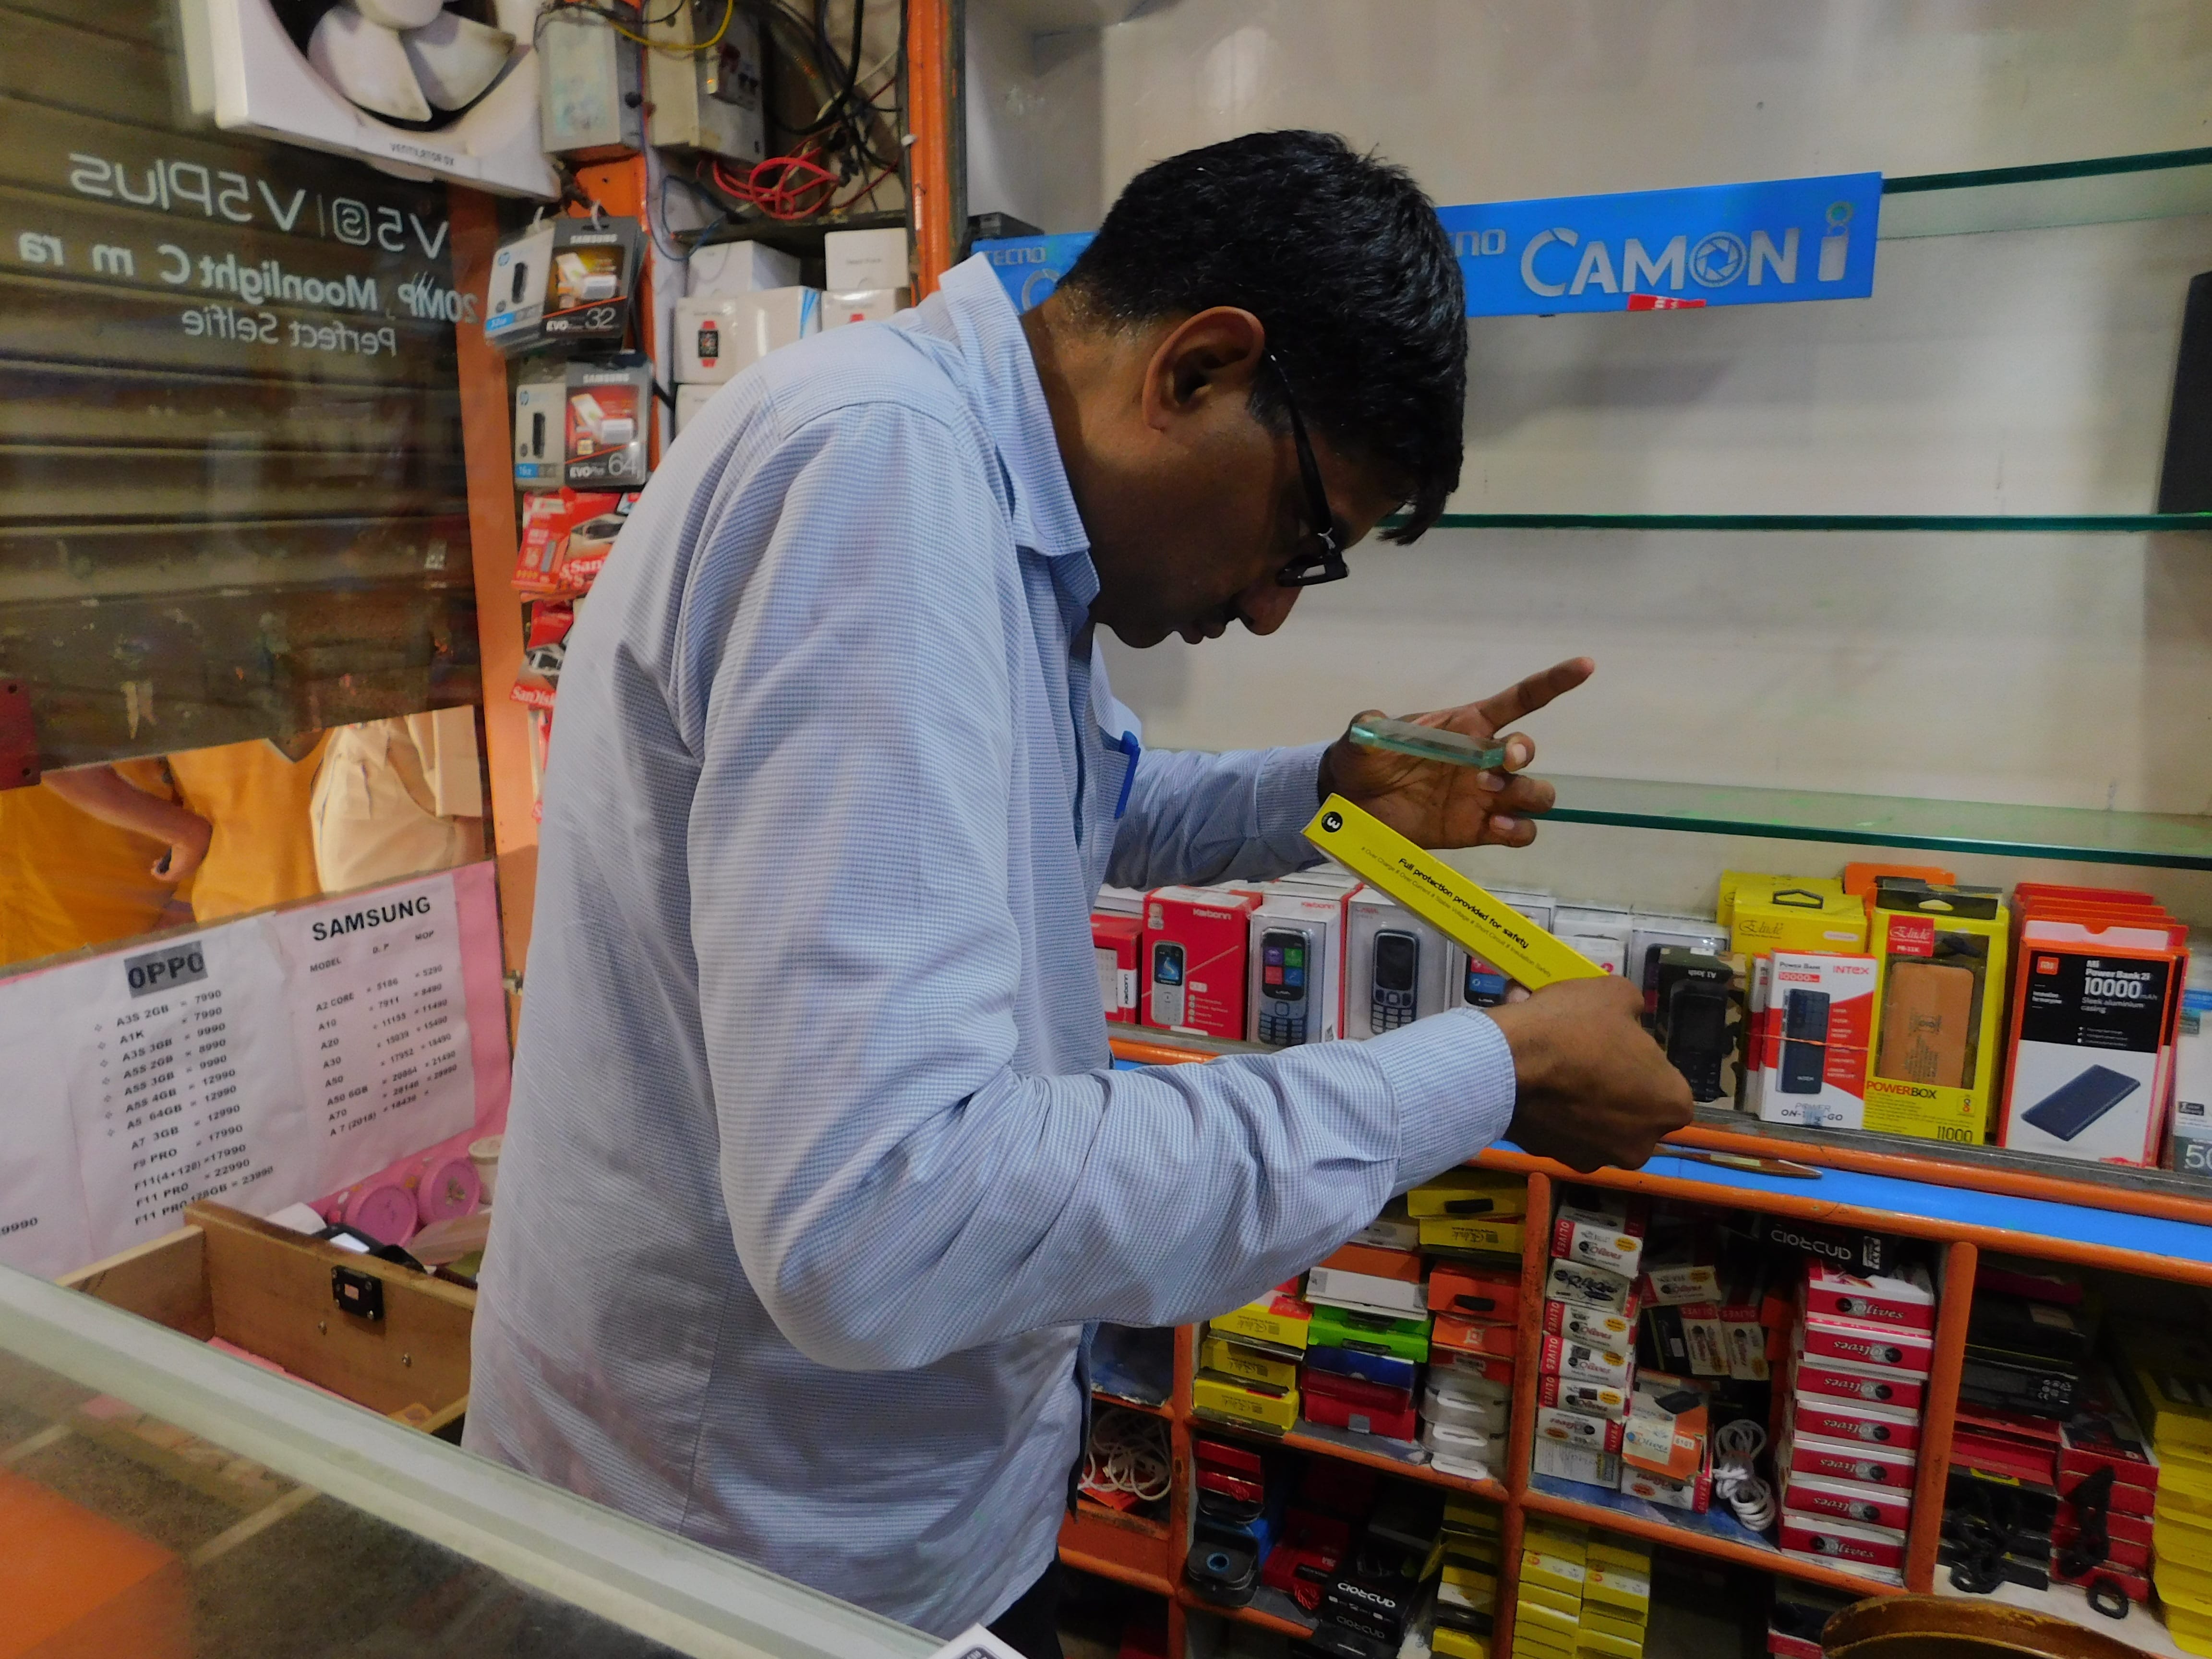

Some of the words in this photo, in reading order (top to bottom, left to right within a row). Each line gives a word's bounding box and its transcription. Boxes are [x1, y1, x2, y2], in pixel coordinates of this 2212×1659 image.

[584, 307, 616, 329] 32
[1398, 857, 1414, 871] Full
[1413, 868, 1453, 898] protection
[1453, 895, 1490, 921] provided
[1488, 918, 1502, 929] for
[1502, 927, 1529, 950] safety
[313, 896, 431, 941] SAMSUNG
[128, 952, 204, 989] OPPO
[310, 957, 342, 973] MODEL
[2085, 968, 2116, 978] Power
[2116, 970, 2140, 980] Bank
[117, 1012, 140, 1027] A3S
[145, 1004, 169, 1019] 2GB
[194, 989, 222, 1004] 7990
[330, 992, 354, 1007] CORE
[120, 1030, 145, 1044] A1K
[194, 1007, 223, 1021] 7990
[197, 1022, 226, 1037] 9990
[318, 1018, 337, 1031] A10
[320, 1037, 339, 1050] A20
[150, 1054, 174, 1070] 2GB
[199, 1054, 227, 1070] 9990
[323, 1057, 342, 1069] A30
[152, 1087, 177, 1103] 4GB
[203, 1069, 236, 1086] 12990
[1866, 1080, 1937, 1100] POWERBOX
[149, 1104, 182, 1120] 64GB
[205, 1085, 237, 1103] 12990
[329, 1108, 347, 1121] A70
[132, 1137, 145, 1150] A7
[153, 1126, 179, 1142] 3GB
[208, 1104, 240, 1121] 12990
[150, 1148, 178, 1163] PRO
[208, 1124, 243, 1142] 17990
[136, 1192, 158, 1208] F11
[163, 1182, 189, 1199] PRO
[215, 1159, 250, 1178] 22990
[135, 1211, 156, 1226] F11
[162, 1200, 187, 1216] PRO
[1555, 1221, 1570, 1253] OLIVES
[1547, 1302, 1560, 1334] OLIVES
[1853, 1299, 1905, 1319] Olives
[1545, 1337, 1558, 1371] OLIVES
[1833, 1340, 1883, 1360] Olives
[1545, 1376, 1555, 1406] OLIVES
[1823, 1377, 1875, 1394] Olives
[1823, 1418, 1873, 1437] Olives
[1819, 1457, 1869, 1476] Olives
[1812, 1496, 1863, 1513] Olives
[1826, 1539, 1875, 1559] Olives
